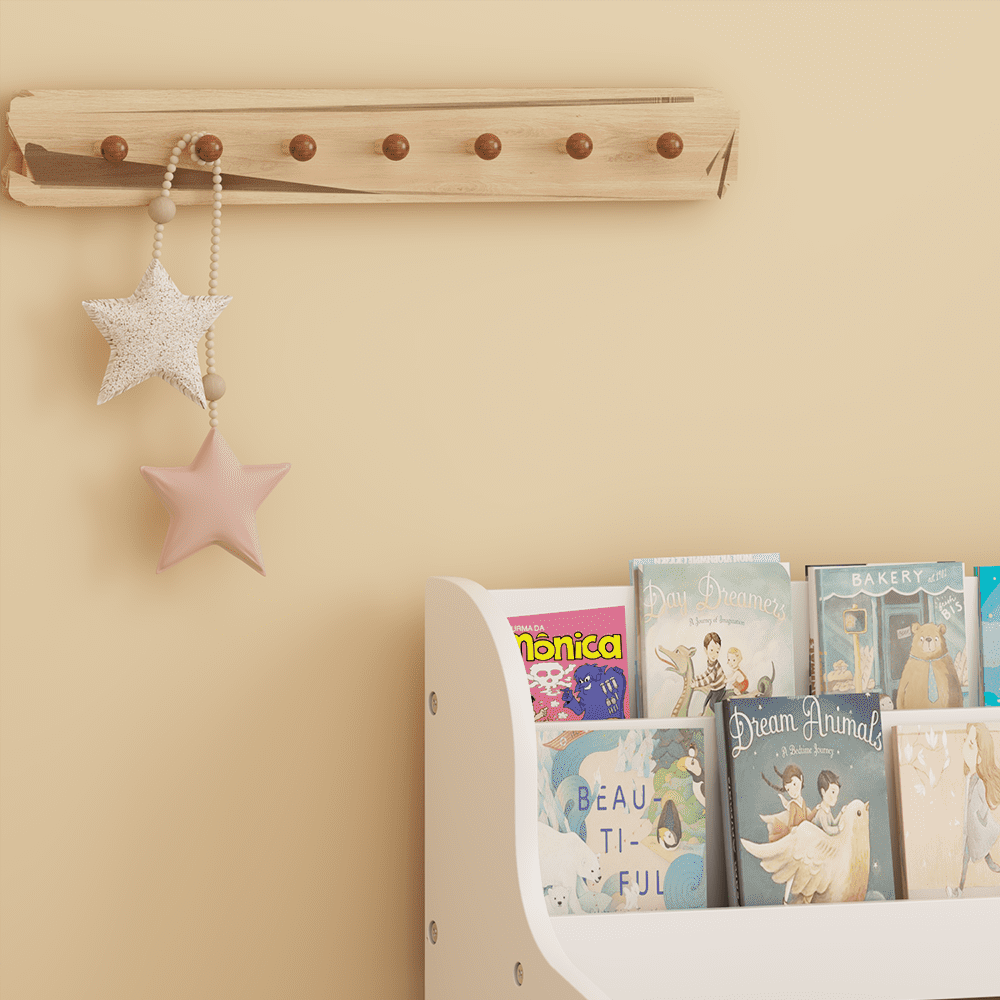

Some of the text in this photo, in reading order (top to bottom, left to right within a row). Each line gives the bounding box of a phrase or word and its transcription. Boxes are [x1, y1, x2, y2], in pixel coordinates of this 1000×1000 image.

[642, 571, 786, 623] Day Dreamers
[851, 569, 923, 587] BAKERY
[729, 695, 883, 758] Dream Animals
[619, 870, 665, 896] FUL
